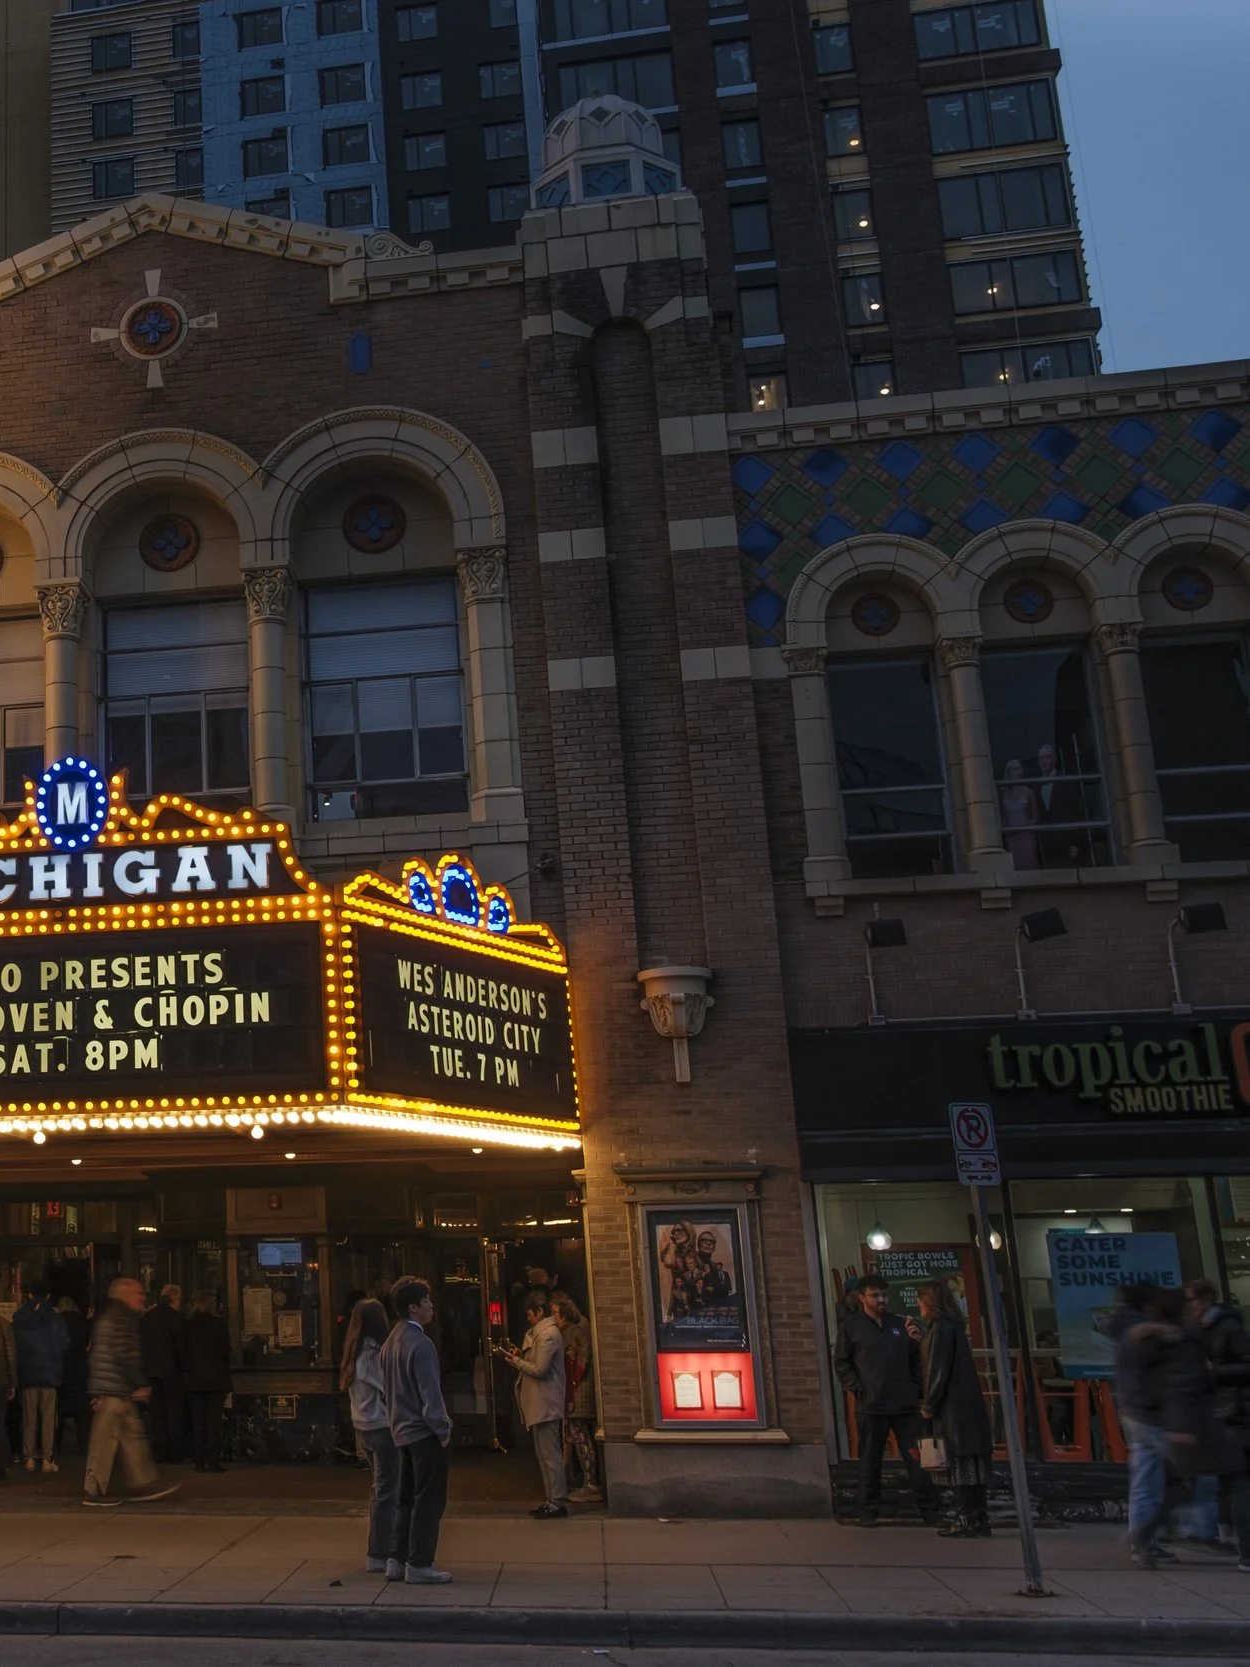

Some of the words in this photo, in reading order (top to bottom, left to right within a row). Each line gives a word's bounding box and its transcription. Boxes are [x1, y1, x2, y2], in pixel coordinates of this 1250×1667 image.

[55, 781, 90, 825] M
[39, 952, 225, 991] PRESENTS
[397, 959, 435, 995] WES
[442, 969, 547, 1020] ANDERSON'S
[93, 1000, 115, 1030] &
[133, 990, 271, 1029] CHOPIN
[407, 1000, 495, 1046] ASTEROID
[502, 1021, 541, 1054] CITY
[85, 1037, 160, 1071] 8PM
[429, 1045, 471, 1080] TUE.
[477, 1053, 487, 1082] 7
[494, 1056, 520, 1088] PM
[986, 1021, 1231, 1099] tropical
[1108, 1083, 1235, 1114] SMOOTHIE
[878, 1252, 915, 1261] TROPIC
[917, 1251, 955, 1260] BOWLS
[1053, 1237, 1127, 1252] CATER
[879, 1260, 904, 1269] JUST
[905, 1260, 928, 1269] GOT
[929, 1259, 959, 1268] MORE
[880, 1268, 931, 1277] TROPICAL
[1056, 1254, 1121, 1269] SOME
[1058, 1271, 1175, 1287] SUNSHINE
[686, 1316, 718, 1325] BLACK
[719, 1316, 740, 1325] BAG
